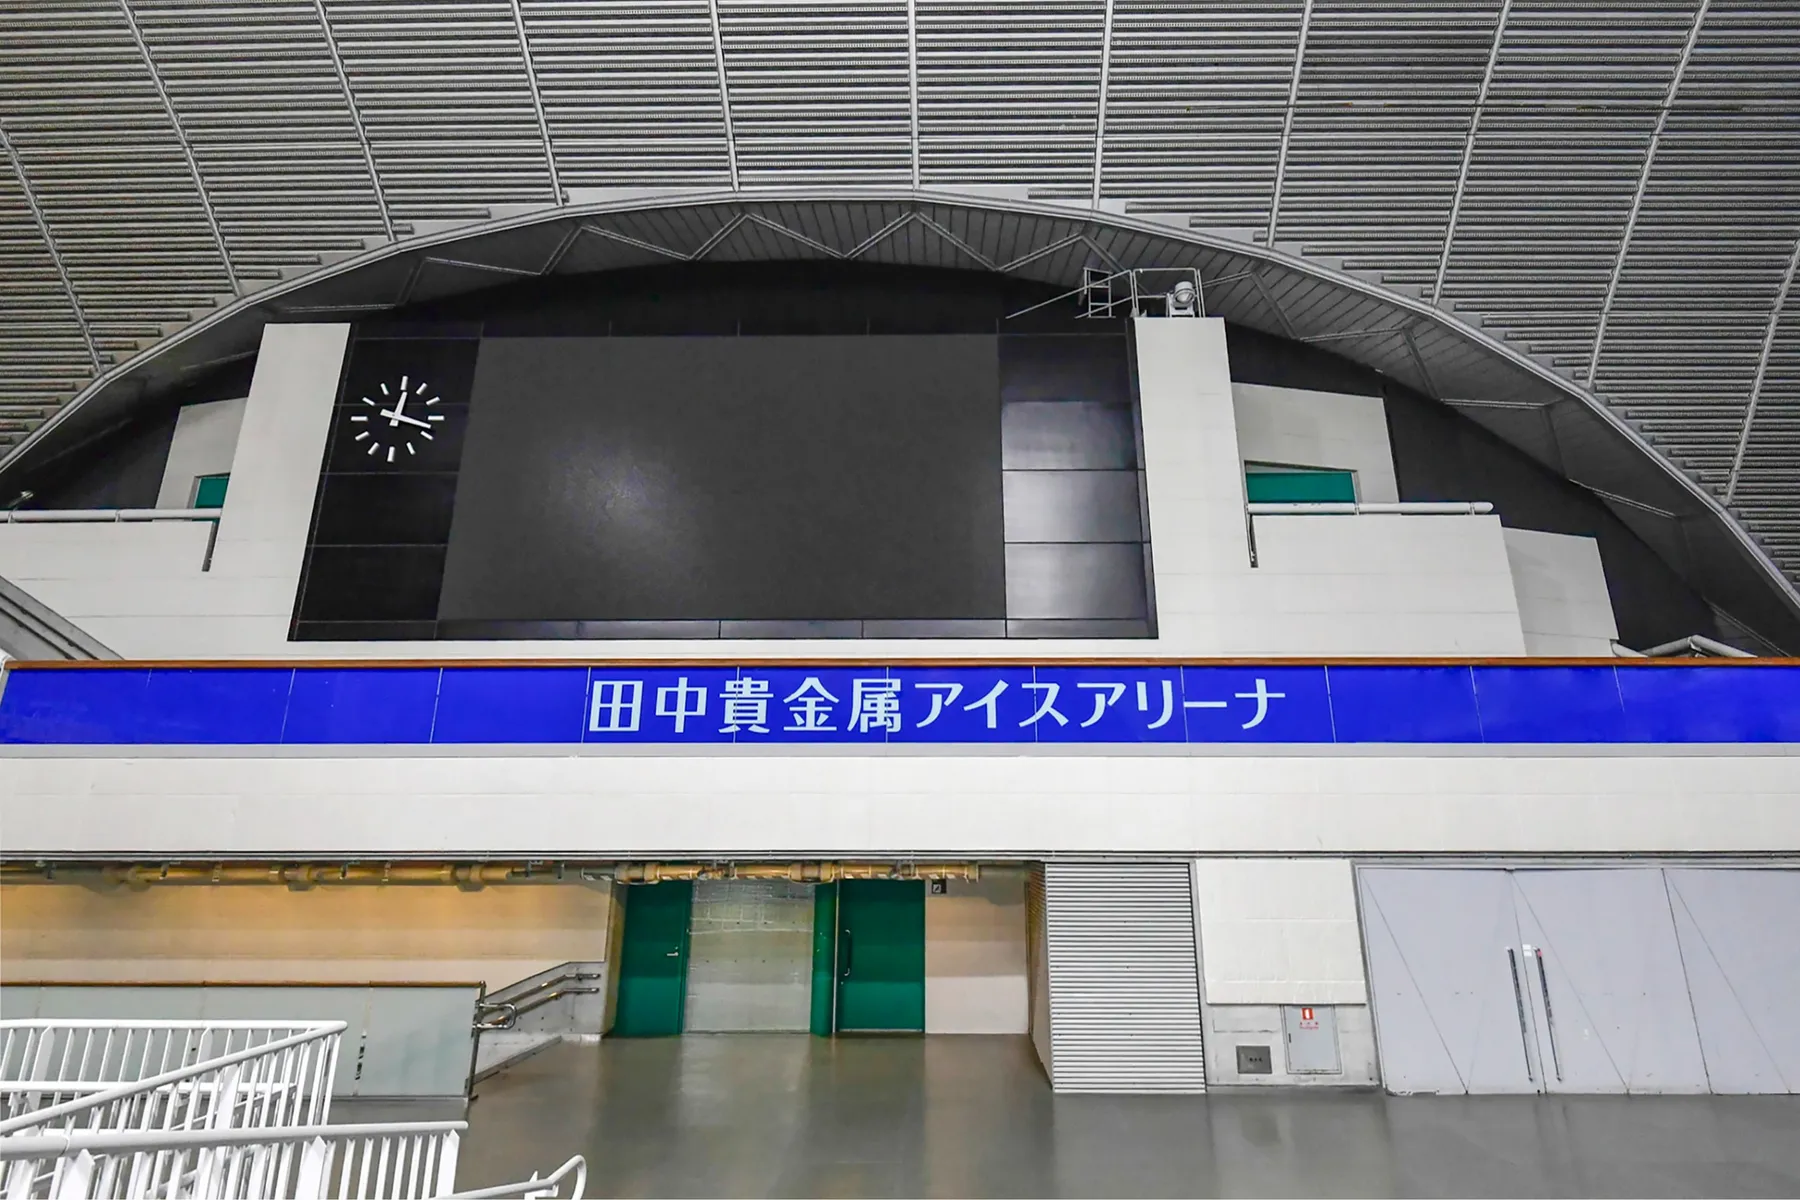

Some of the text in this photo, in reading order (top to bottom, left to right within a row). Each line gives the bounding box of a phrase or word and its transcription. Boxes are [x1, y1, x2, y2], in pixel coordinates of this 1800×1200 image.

[588, 677, 1286, 733] 田中貴金属アイスアリーナ
